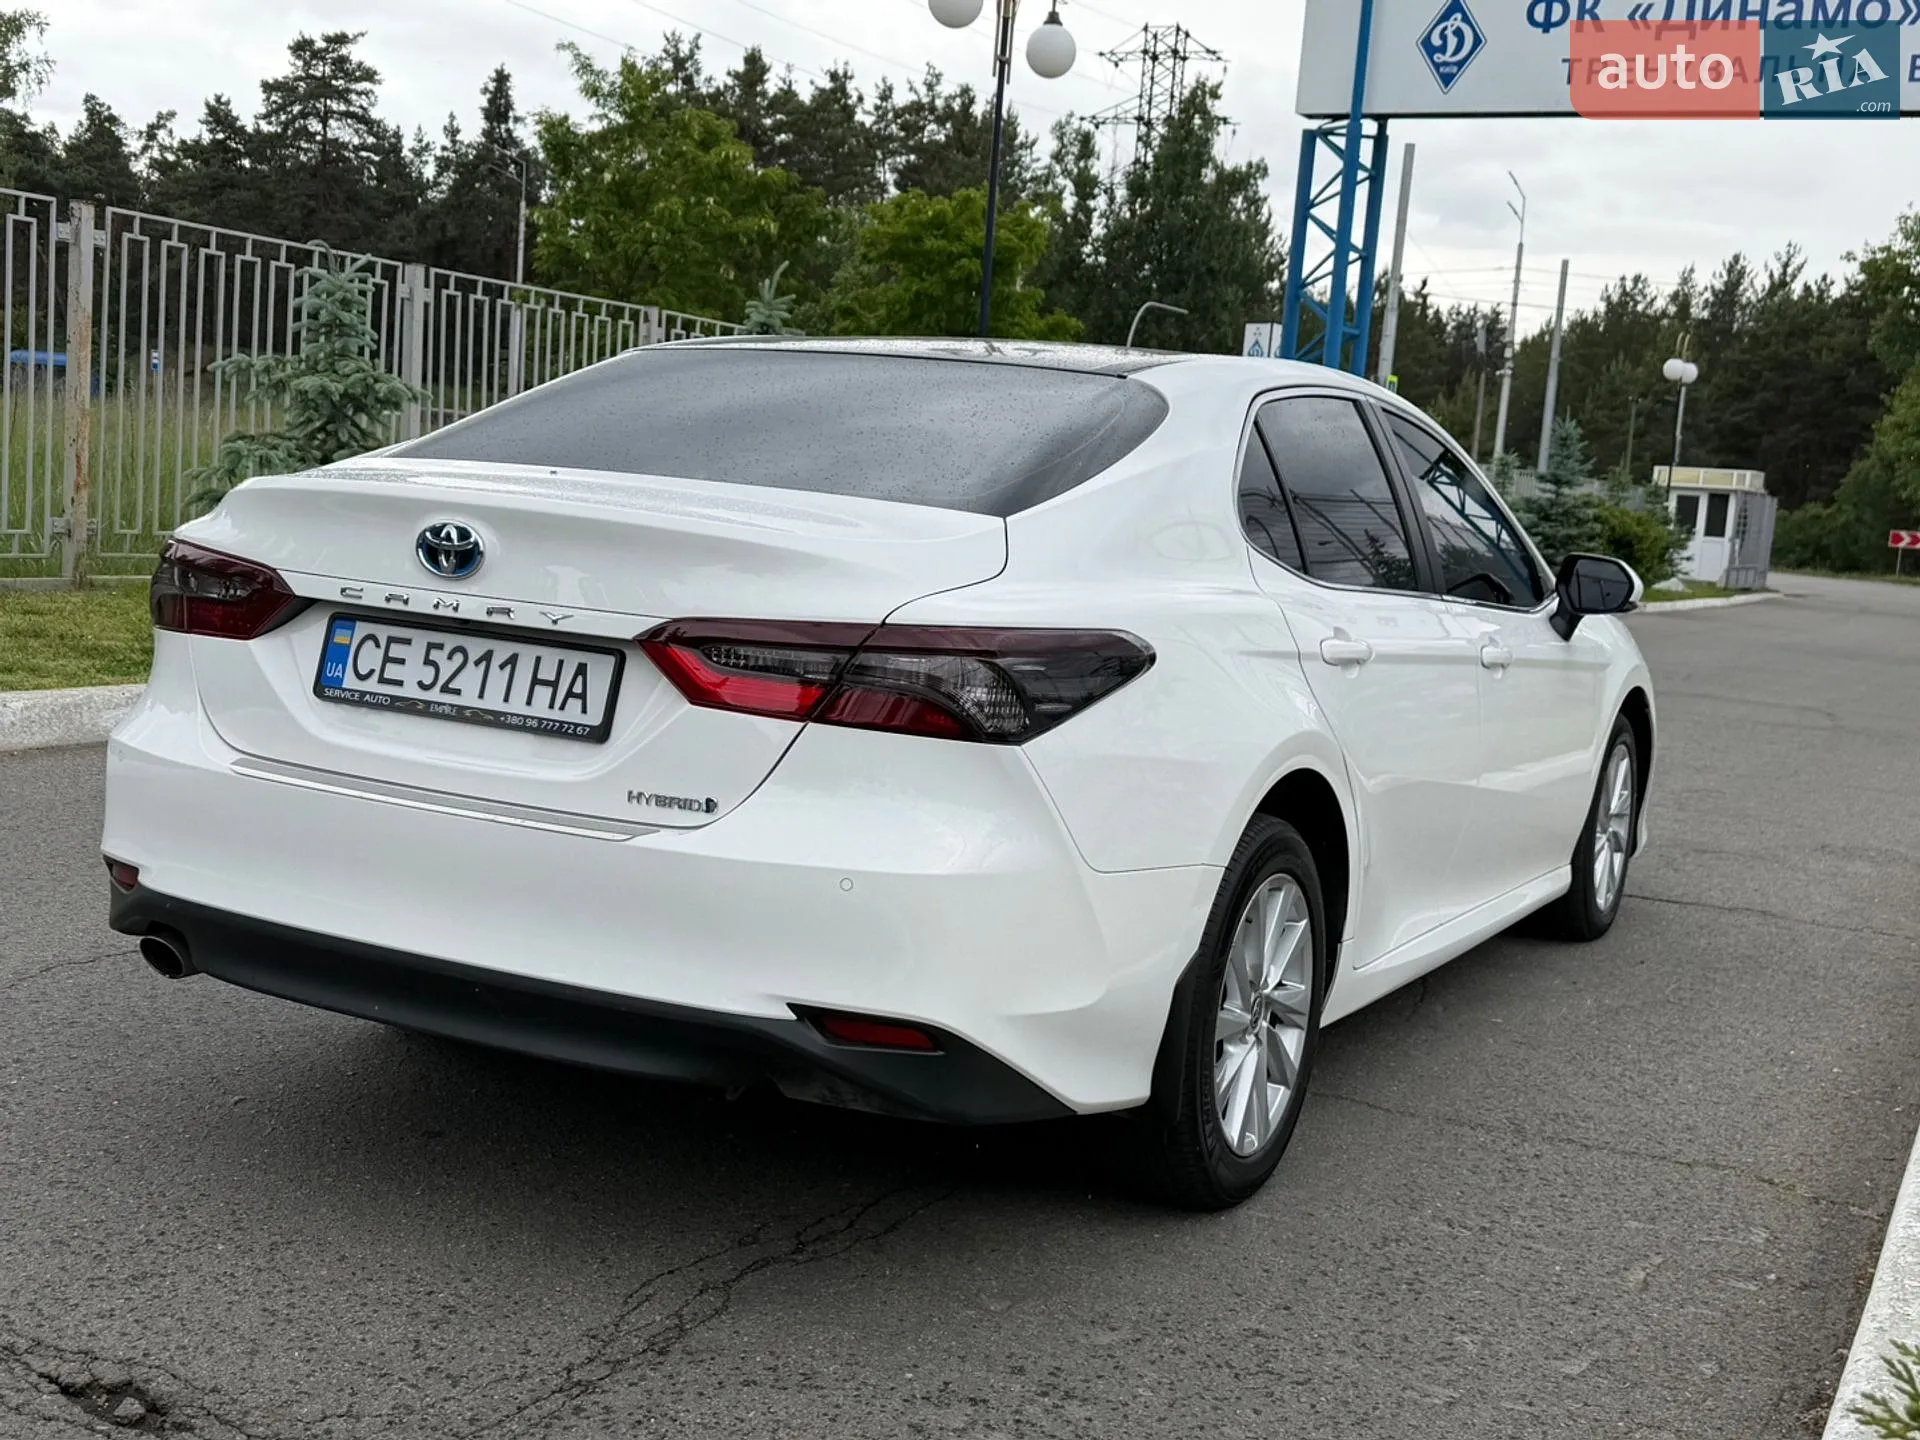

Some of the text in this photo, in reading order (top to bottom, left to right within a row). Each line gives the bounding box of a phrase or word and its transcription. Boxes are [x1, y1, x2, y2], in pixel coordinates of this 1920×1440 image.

[1526, 0, 1605, 34] ФК
[339, 586, 575, 626] CAMRY
[326, 662, 343, 680] UA
[352, 632, 590, 715] CE 5211 HA
[324, 687, 360, 701] SERVICE
[363, 693, 391, 706] AUTO
[525, 718, 539, 729] 96
[540, 720, 559, 732] 777
[561, 723, 574, 734] 72
[576, 726, 590, 736] 67
[627, 789, 702, 812] HYBRID
